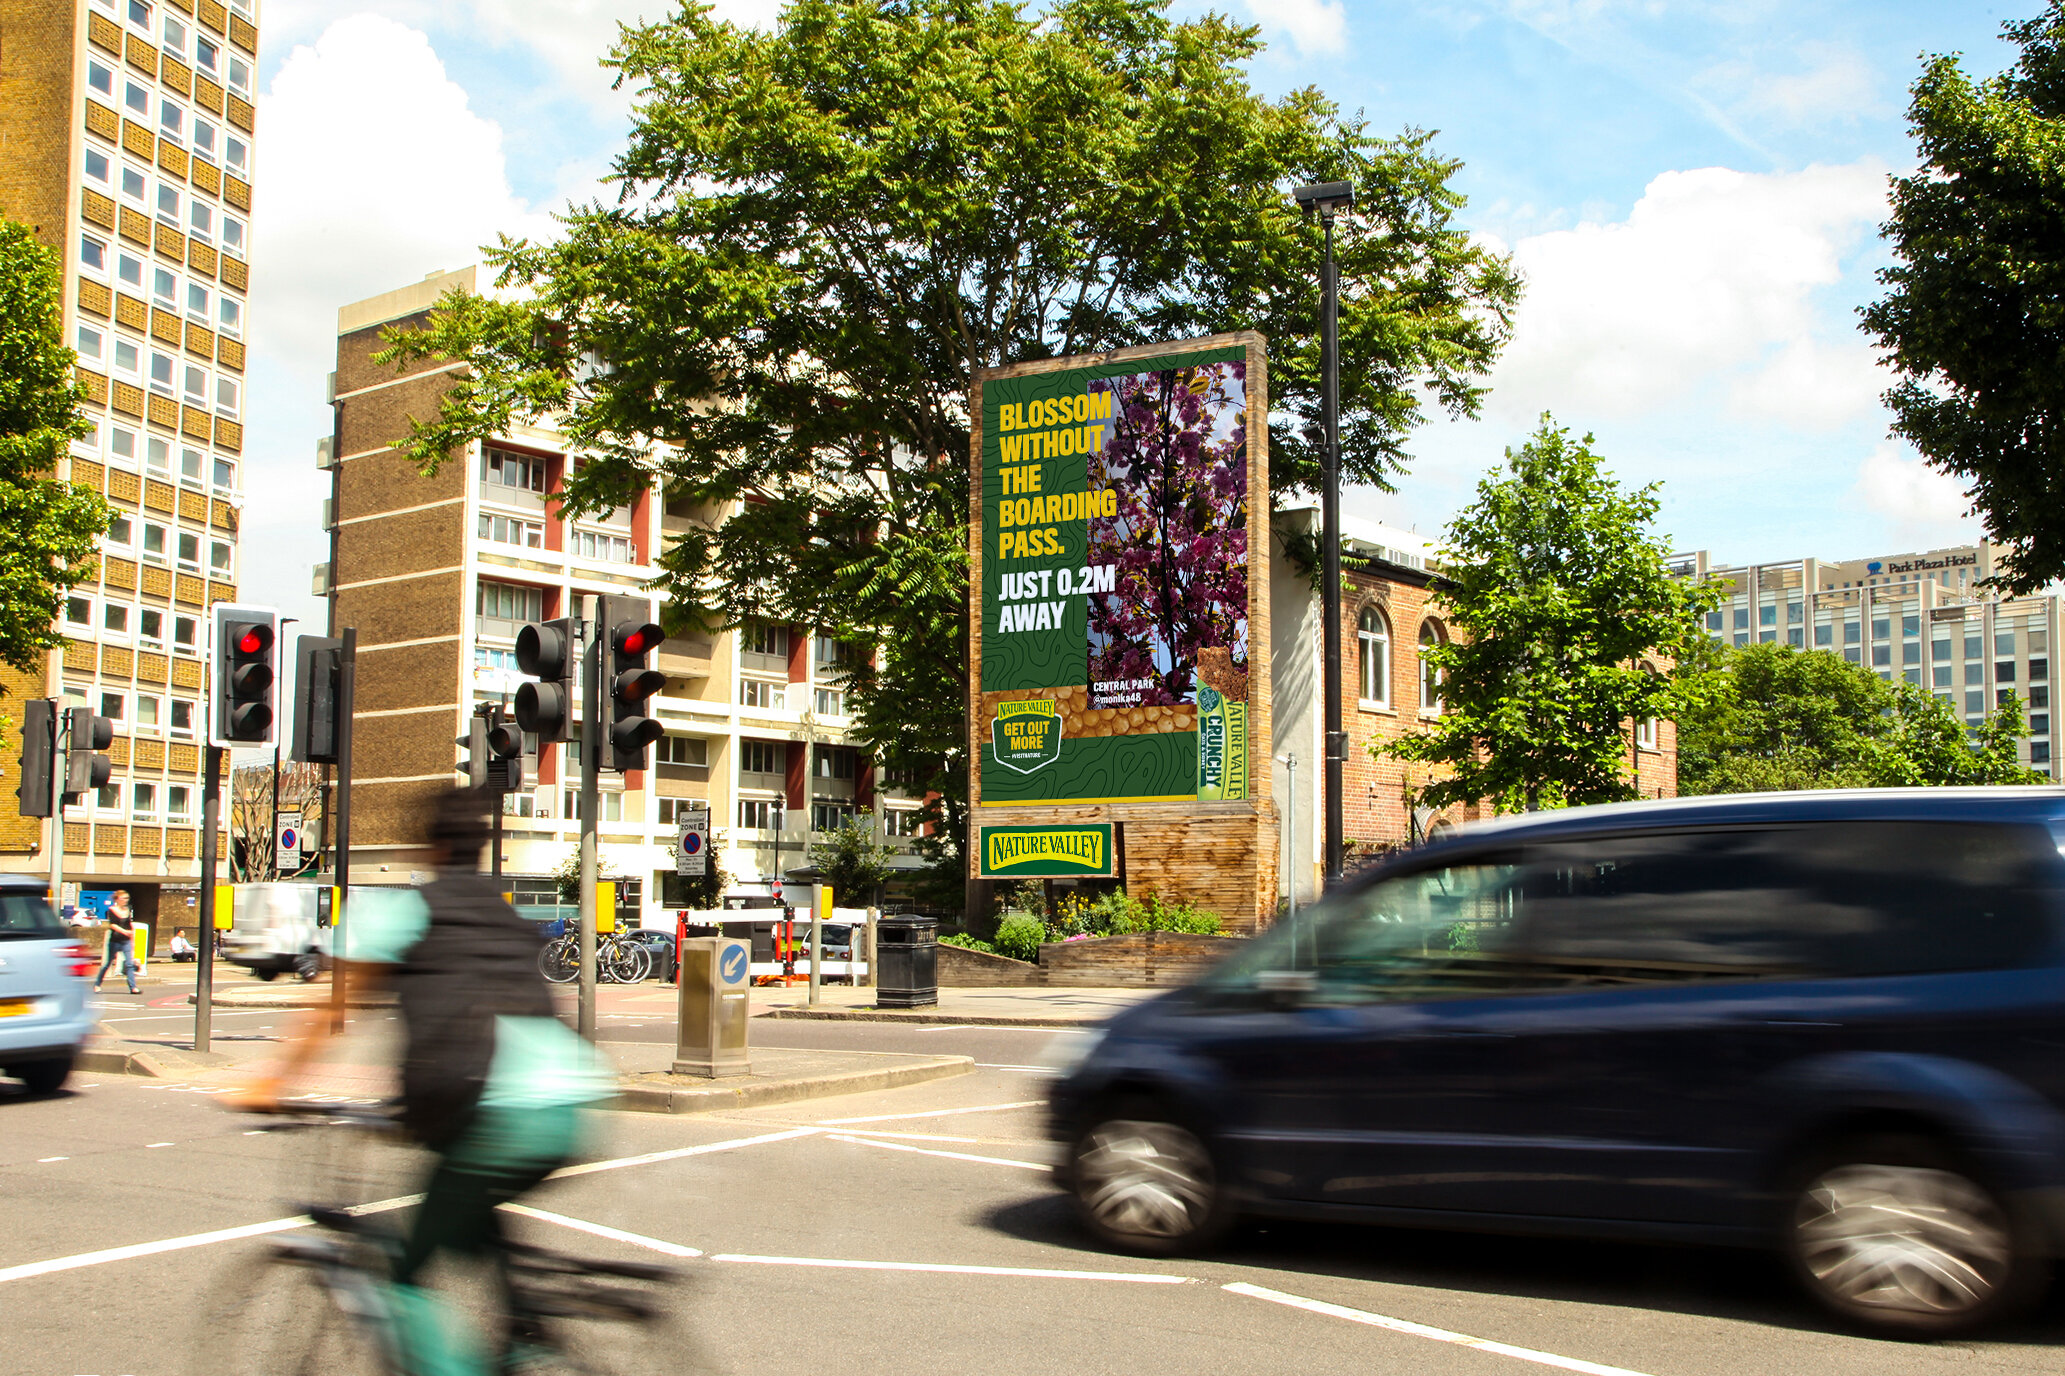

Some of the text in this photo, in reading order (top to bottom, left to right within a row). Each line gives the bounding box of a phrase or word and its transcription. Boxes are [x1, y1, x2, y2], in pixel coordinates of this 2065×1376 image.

[1000, 390, 1111, 432] BLOSSOM
[999, 424, 1105, 463] WITHOUT
[999, 464, 1042, 495] THE
[999, 489, 1117, 528] BOARDING
[999, 528, 1065, 560] PASS.
[1888, 553, 1976, 573] Park Plaza Hotel
[999, 564, 1116, 601] JUST 0.2M
[998, 601, 1067, 633] AWAY
[1093, 679, 1155, 692] CENTRAL PARK
[1093, 692, 1142, 704] @monika48
[1000, 701, 1053, 718] NATURE VALLEY
[1003, 720, 1050, 737] GET OUT
[1010, 735, 1044, 751] MORE
[1207, 715, 1223, 788] CRUNCHY
[993, 835, 1100, 865] NATURE VALLEY
